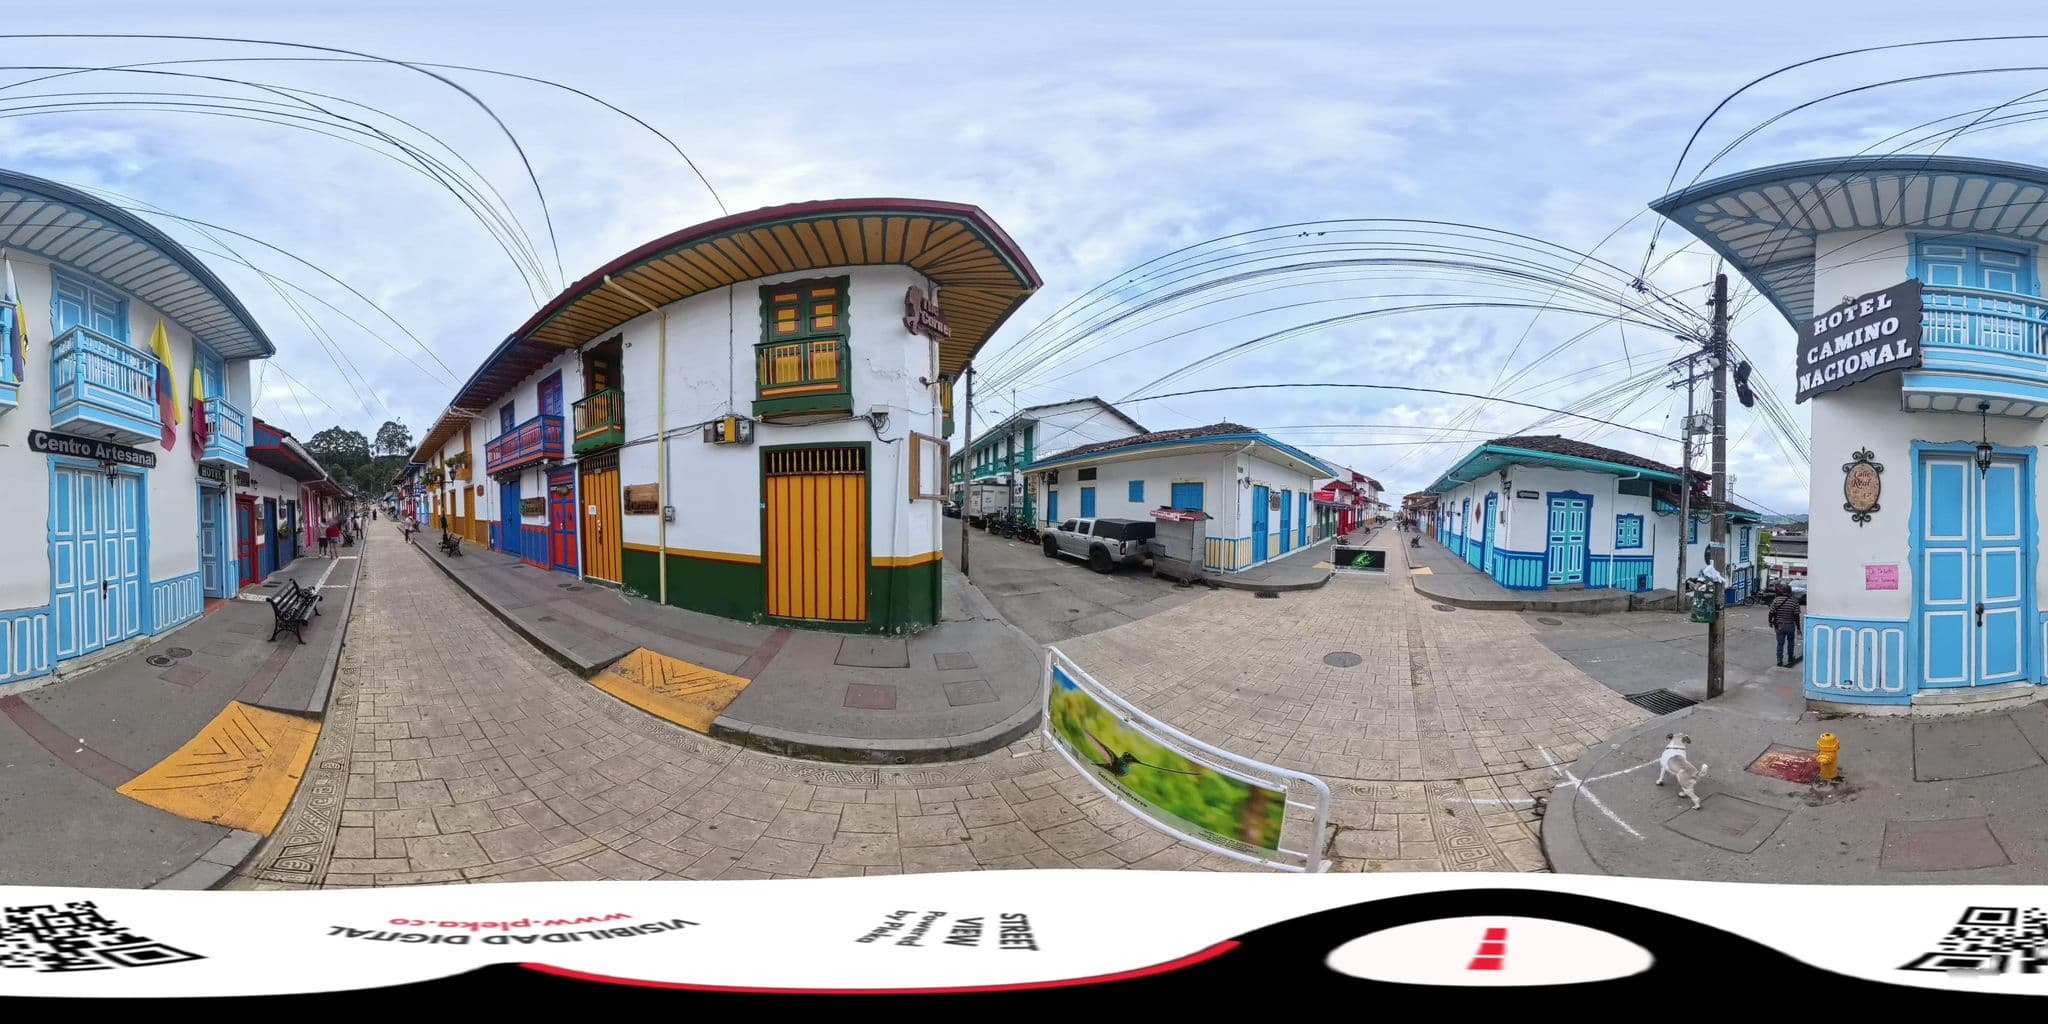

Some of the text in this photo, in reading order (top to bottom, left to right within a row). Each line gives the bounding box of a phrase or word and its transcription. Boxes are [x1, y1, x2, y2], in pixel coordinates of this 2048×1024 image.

[921, 311, 953, 338] Corner
[1814, 294, 1893, 336] HOTEL
[1807, 317, 1900, 365] CAMINO
[1799, 338, 1913, 393] NACIONAL
[34, 432, 155, 467] Centro Artesanal
[1851, 478, 1872, 490] Real
